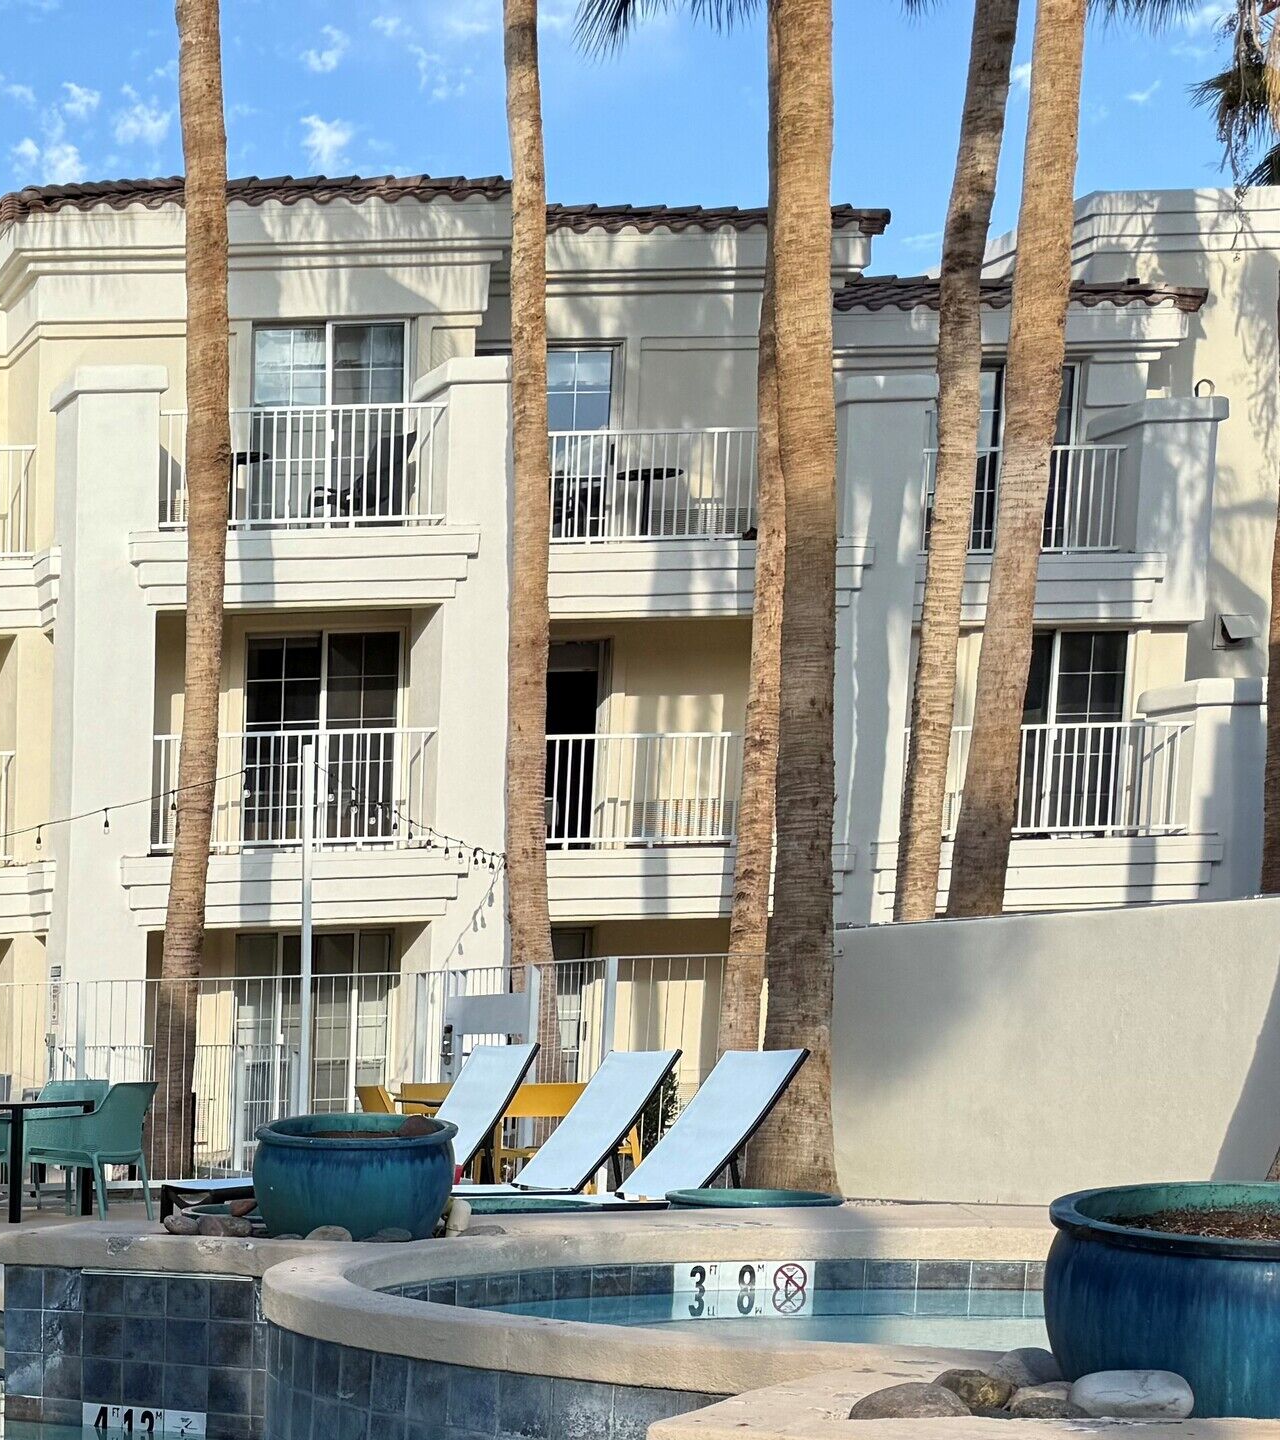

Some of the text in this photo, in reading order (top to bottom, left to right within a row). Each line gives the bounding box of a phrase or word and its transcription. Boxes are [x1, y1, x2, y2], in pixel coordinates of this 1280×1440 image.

[709, 1264, 718, 1275] FT
[111, 1407, 120, 1418] FT
[155, 1410, 162, 1420] M
